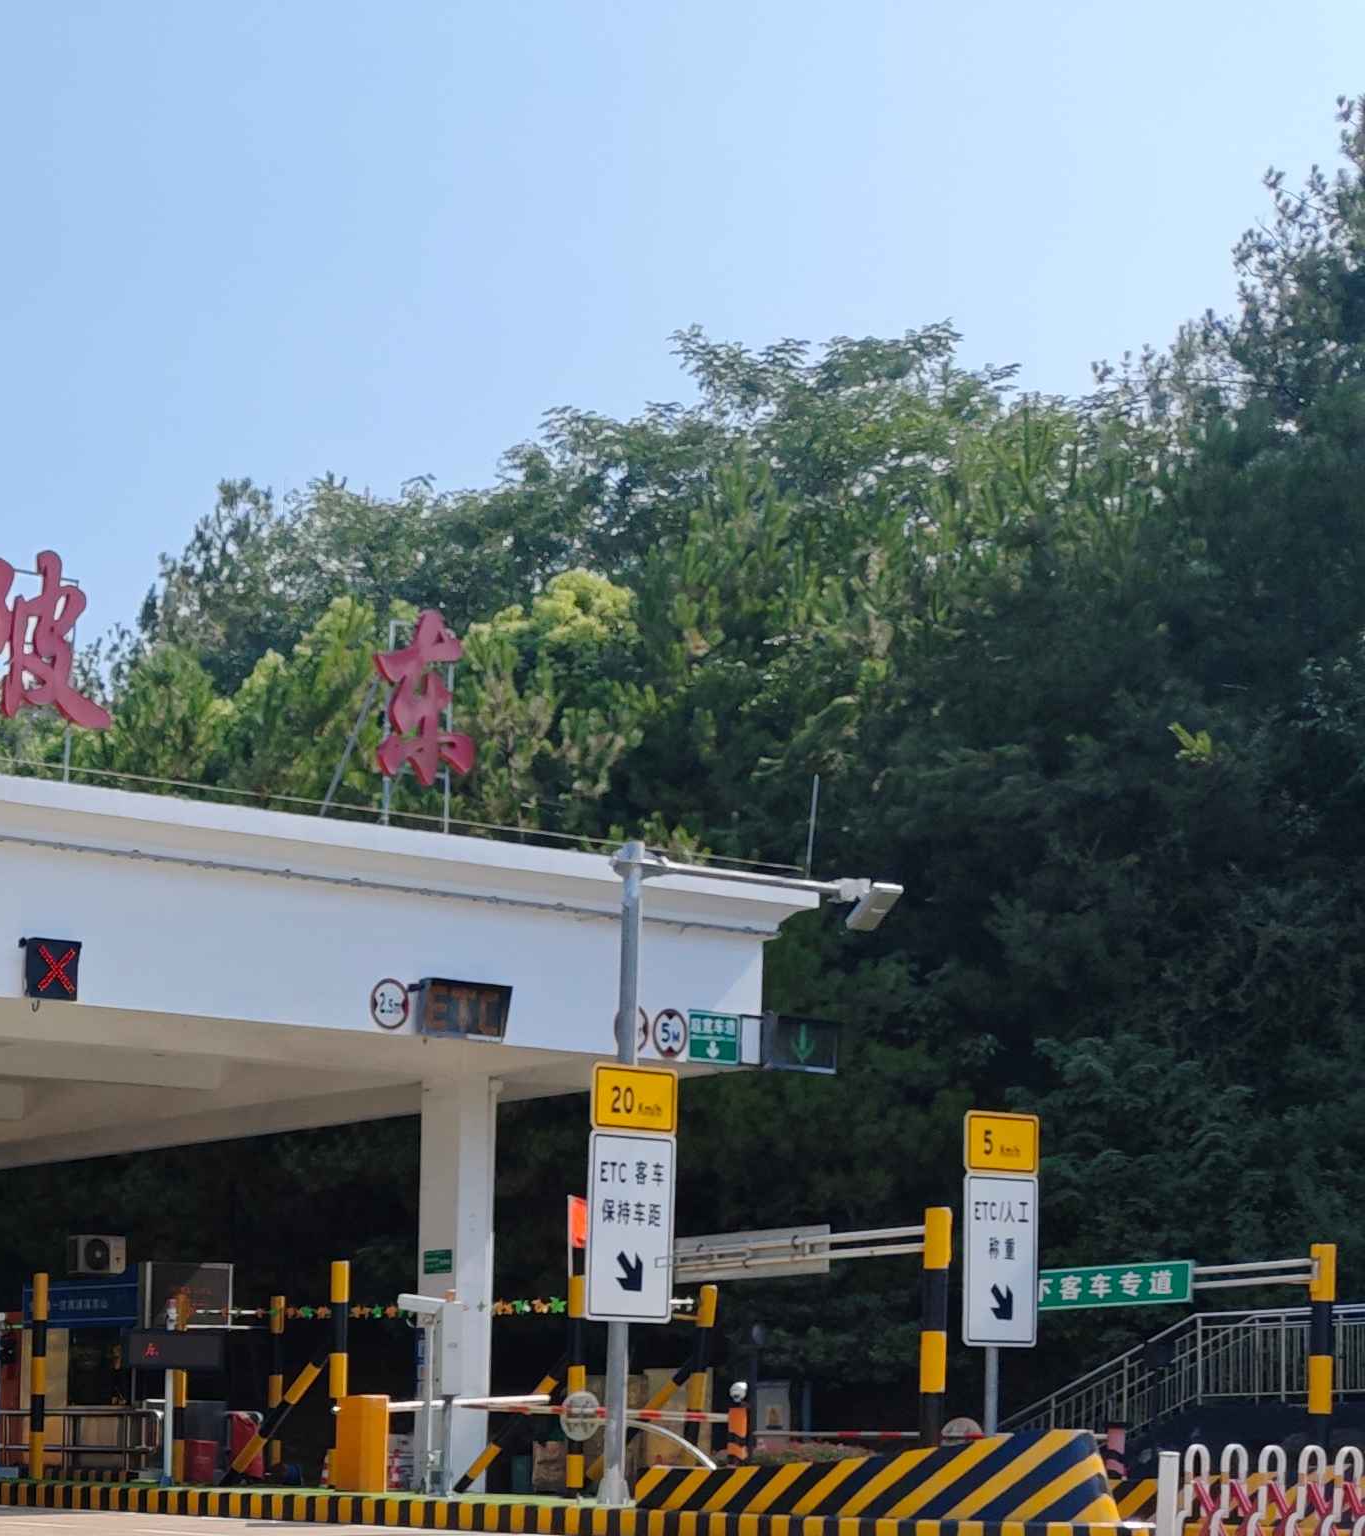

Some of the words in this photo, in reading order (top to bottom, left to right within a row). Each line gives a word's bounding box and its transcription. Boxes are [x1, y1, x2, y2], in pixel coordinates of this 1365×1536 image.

[425, 984, 501, 1036] ETC
[611, 1085, 634, 1114] 20
[983, 1129, 994, 1156] 5
[600, 1160, 627, 1184] ETC
[635, 1159, 665, 1187] 客车
[602, 1198, 661, 1228] 保持车距
